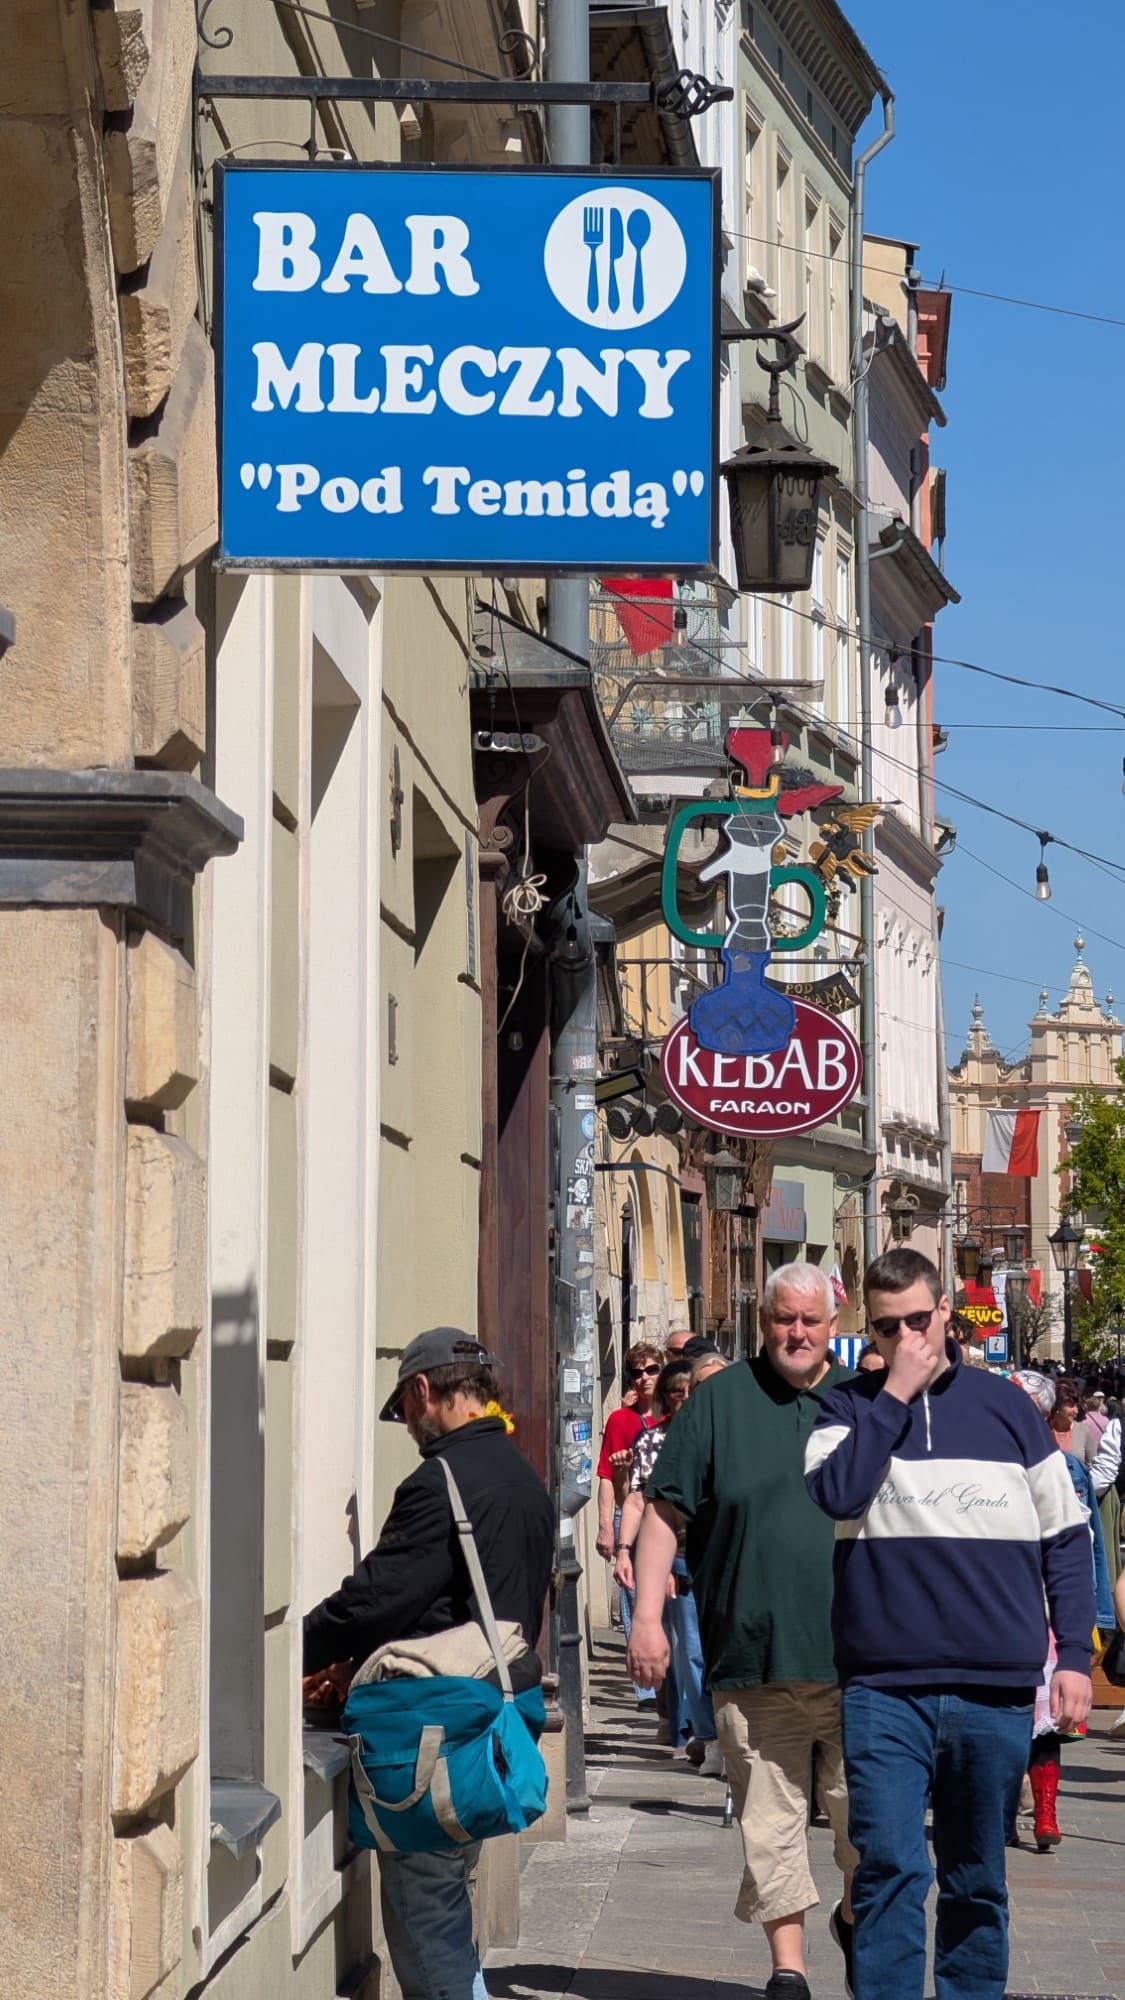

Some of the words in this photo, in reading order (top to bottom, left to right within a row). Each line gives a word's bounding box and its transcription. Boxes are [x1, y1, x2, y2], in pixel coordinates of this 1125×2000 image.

[253, 212, 479, 296] BAR
[252, 342, 690, 418] MLECZNY
[241, 464, 403, 513] "Pod
[423, 467, 703, 528] Temidą"
[785, 984, 813, 994] POD
[678, 1036, 848, 1091] KEBAB
[710, 1100, 811, 1115] FARAON
[872, 1481, 914, 1506] Riva
[917, 1488, 951, 1507] del
[951, 1482, 1009, 1514] Garda
